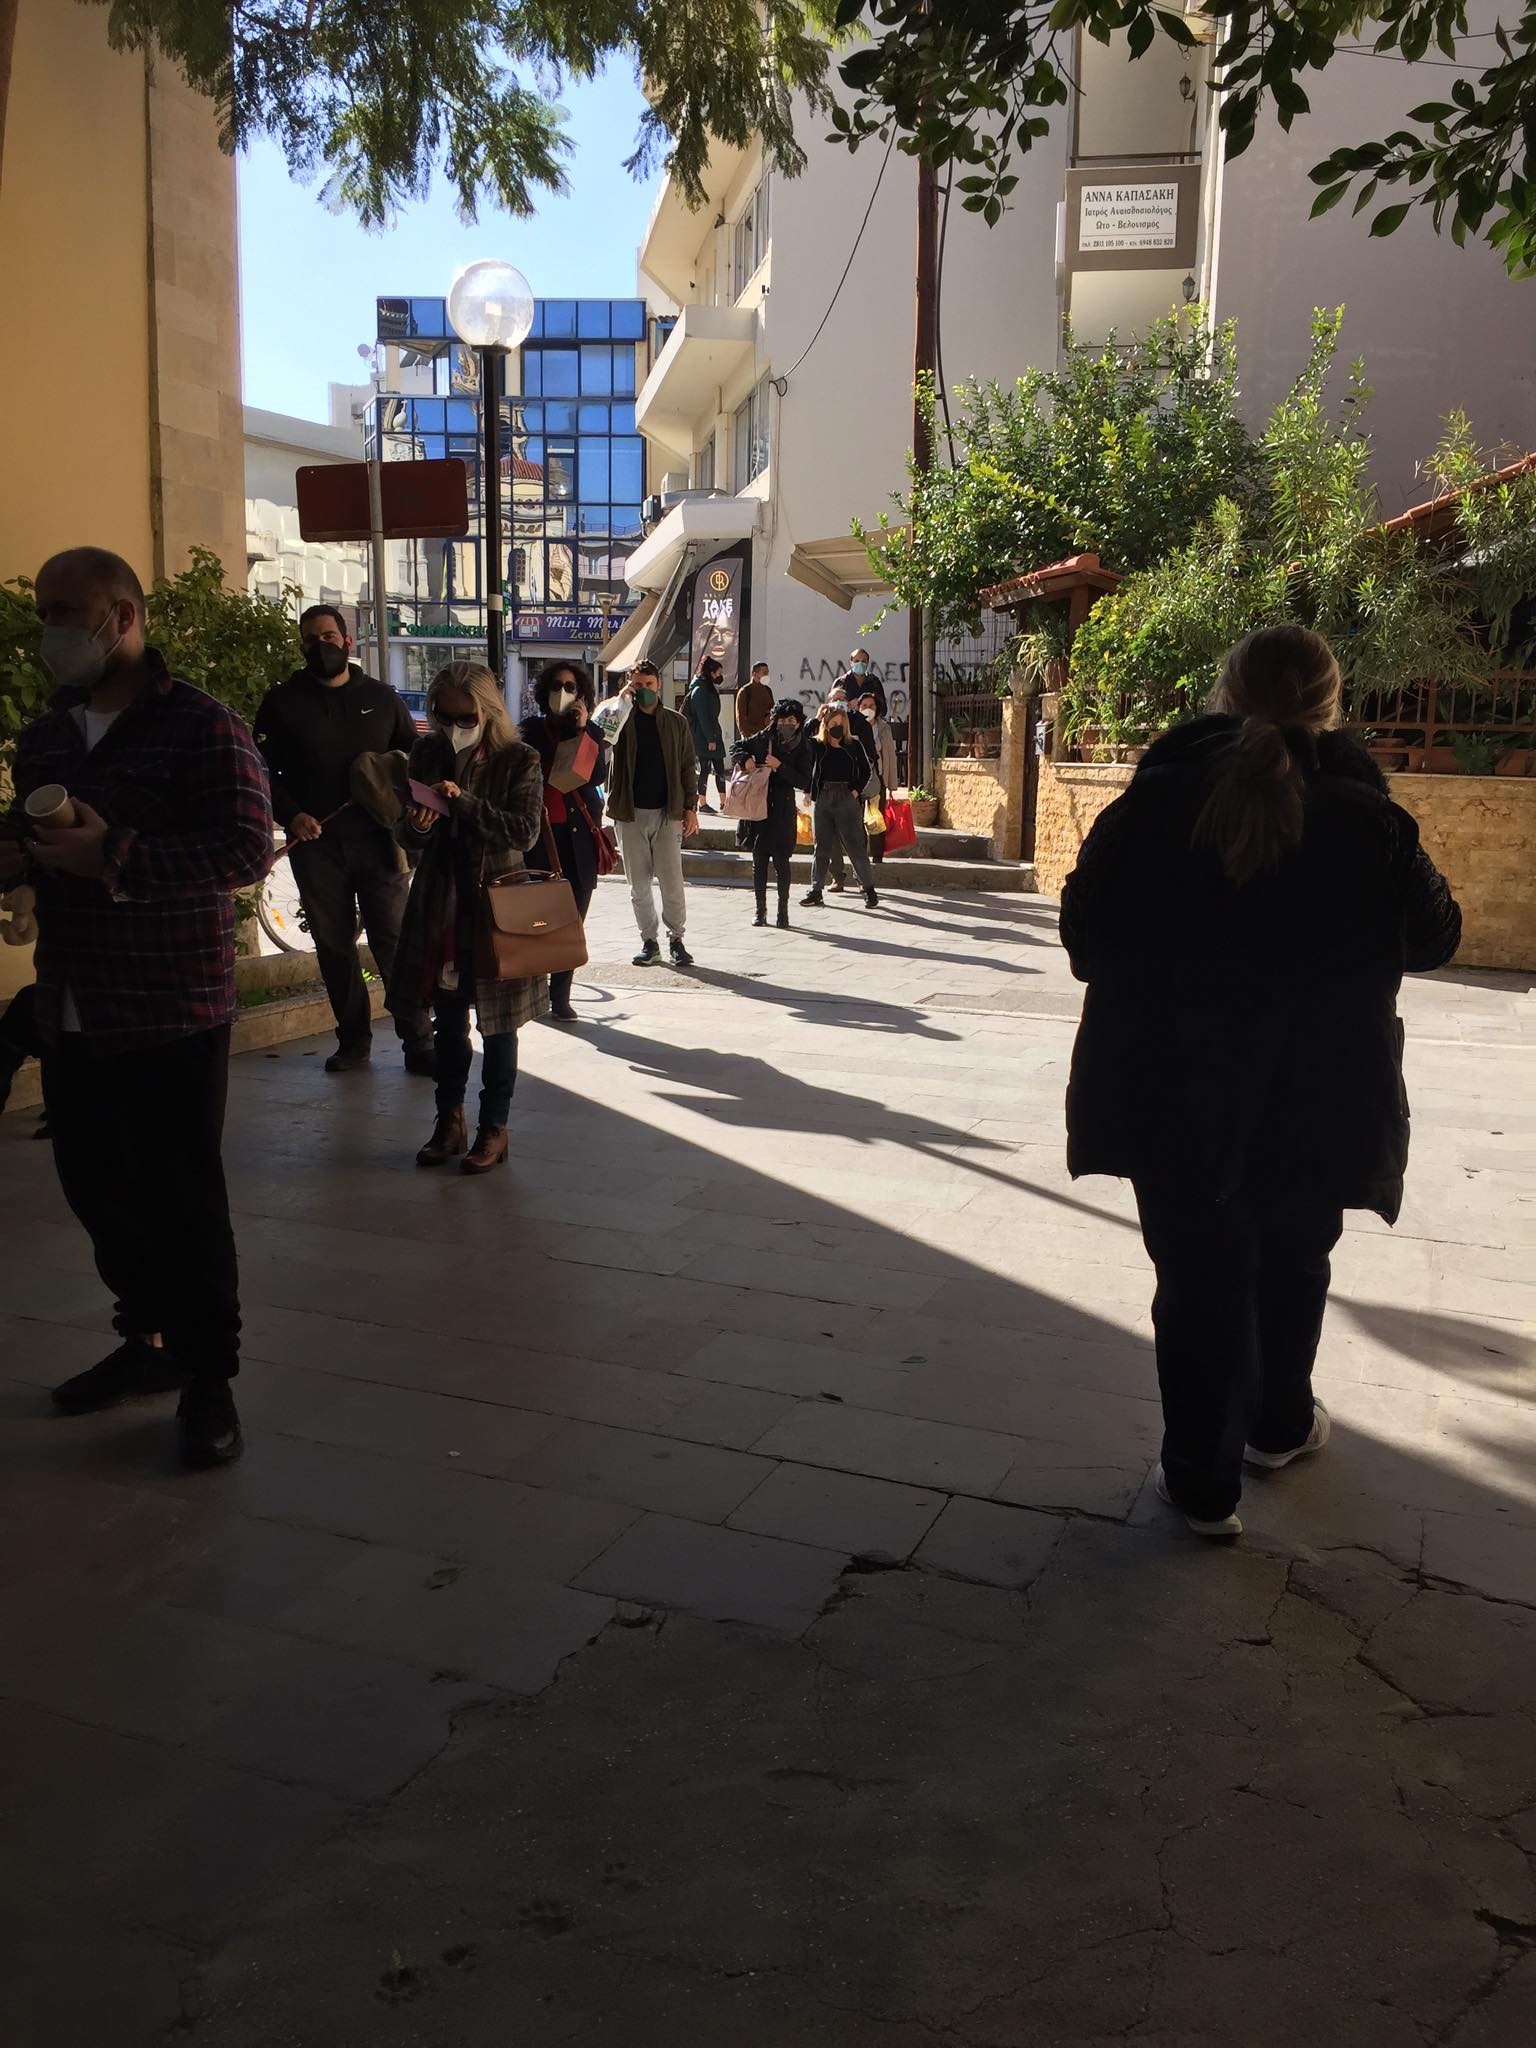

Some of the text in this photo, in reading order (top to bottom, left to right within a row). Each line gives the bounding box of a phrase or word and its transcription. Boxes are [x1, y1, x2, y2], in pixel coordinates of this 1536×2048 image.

[1085, 189, 1174, 202] ΑΝΝΑ ΚΑΠΑΣΑΚΗ
[1085, 205, 1172, 217] Ιατρός Αναισθησιολόγος
[1096, 220, 1110, 230] Ωτο
[1118, 219, 1160, 229] Βελονισμός
[703, 598, 733, 610] TAKE
[702, 608, 733, 619] AWAY
[546, 616, 581, 628] Mini
